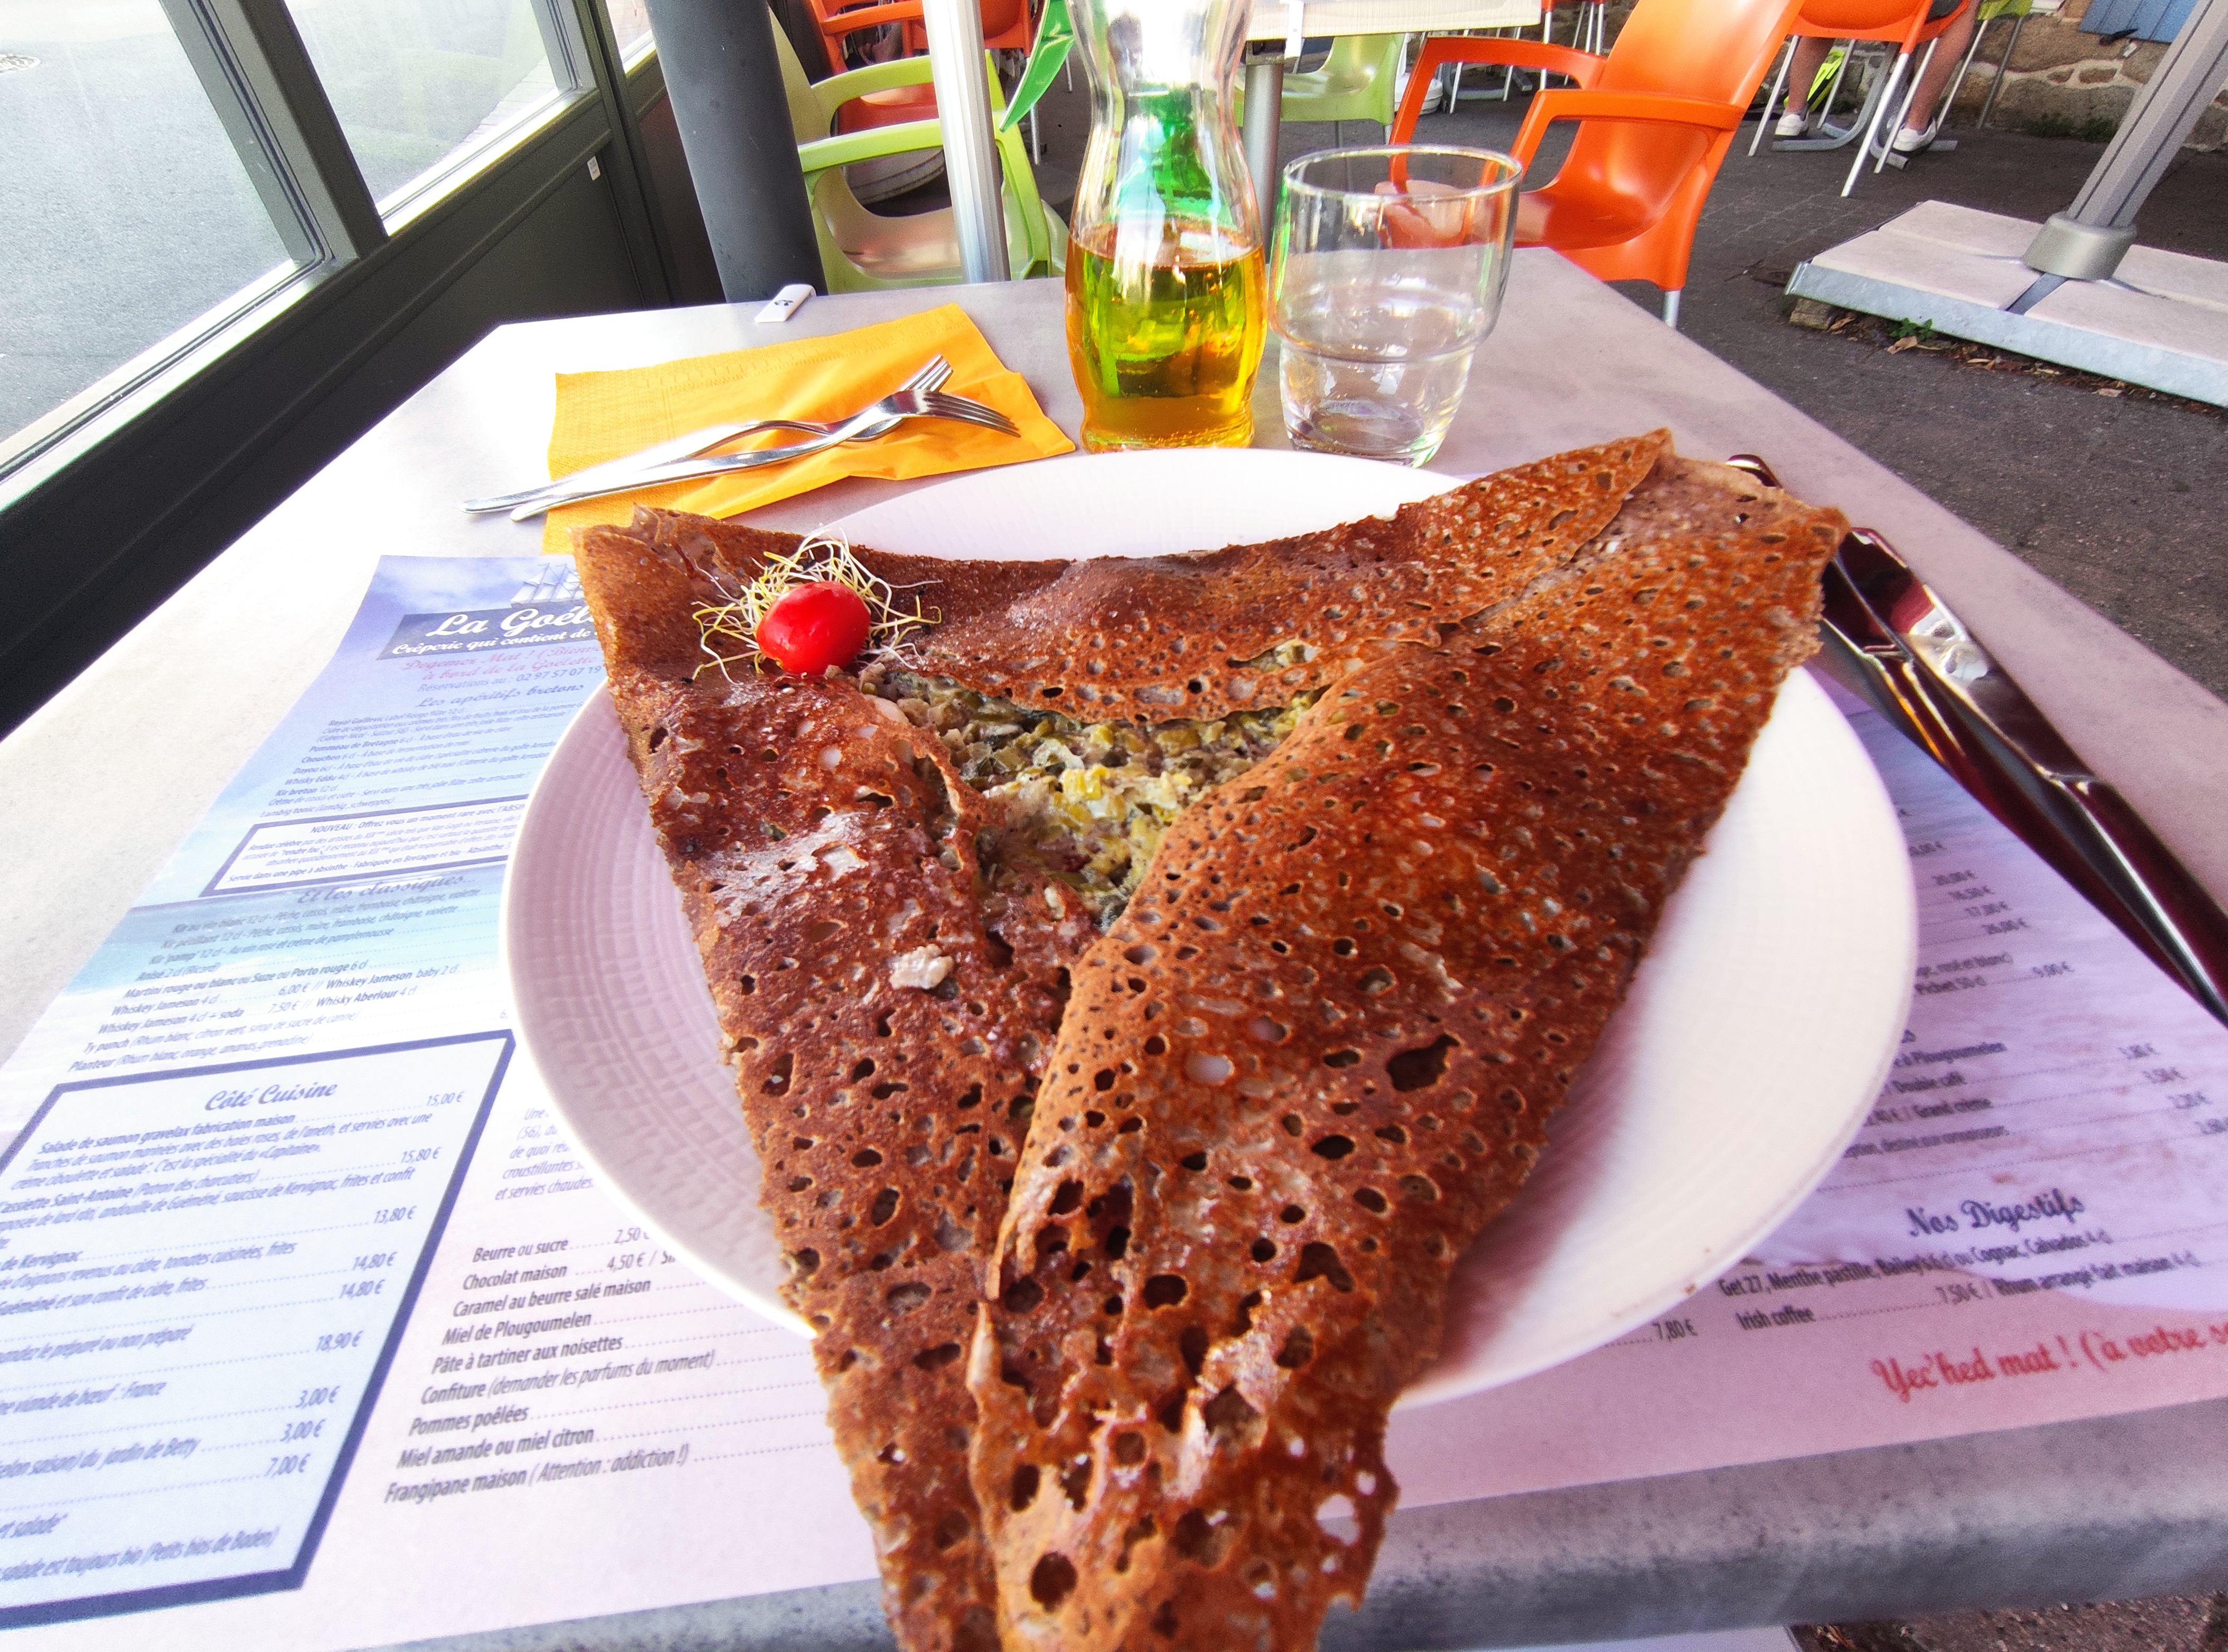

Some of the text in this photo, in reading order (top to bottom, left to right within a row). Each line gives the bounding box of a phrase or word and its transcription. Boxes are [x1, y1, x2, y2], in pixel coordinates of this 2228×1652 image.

[425, 605, 595, 637] La Goél
[392, 628, 591, 654] Crêperie qui contient de
[418, 678, 489, 693] Réservations
[517, 673, 533, 682] 02
[533, 671, 551, 680] 97
[551, 669, 568, 678] 57
[569, 668, 586, 677] 07
[589, 665, 602, 674] 19
[415, 684, 585, 708] Les apéritifs bretons
[310, 823, 353, 833] NOUVEAU
[358, 820, 384, 829] Offrez
[419, 812, 457, 822] moment
[111, 967, 441, 1016] Whiskey Jameson 6,00 € Whiskey Jameson baby
[123, 964, 350, 999] Martini rouge ou blanc ou Suze ou Porto rouge
[97, 990, 399, 1035] Whiskey Jameson soda 7,50 € Whisky Aberlour
[204, 1084, 338, 1111] Côté Cuisine
[37, 1139, 78, 1155] Salade
[77, 1136, 95, 1150] de
[93, 1133, 141, 1148] saumon
[191, 1119, 254, 1136] fabrication
[253, 1115, 296, 1128] maison
[426, 1092, 456, 1107] 15,00
[456, 1091, 464, 1103] €
[338, 1113, 433, 1134] et servies avec une
[524, 1108, 546, 1120] Une
[401, 1146, 441, 1163] 15,80 €
[509, 1145, 551, 1160] de quoi
[370, 1172, 384, 1185] et
[382, 1166, 416, 1183] confit
[502, 1160, 574, 1180] croustillantes
[495, 1187, 509, 1201] et
[507, 1184, 546, 1199] servies
[374, 1205, 417, 1224] 13,80 €
[1905, 1188, 2085, 1237] Nos Digestifs
[472, 1227, 642, 1263] Beurre ou sucre 2,50
[352, 1251, 398, 1271] 14,80 €
[462, 1252, 645, 1290] Chocolat maison 4,50 €
[339, 1279, 385, 1299] 14,80 €
[1717, 1278, 1748, 1297] Get
[1742, 1274, 1772, 1294] 27,
[1766, 1268, 1825, 1290] Menthe
[1822, 1260, 1882, 1288] pastille,
[453, 1280, 651, 1317] Caramel au beurre salé maison
[1735, 1309, 1773, 1331] Irish
[1770, 1304, 1817, 1326] coffee
[1934, 1283, 1971, 1306] 7,50
[1966, 1282, 1983, 1300] €
[316, 1330, 364, 1352] 18,90 €
[442, 1311, 592, 1345] Miel de Plougoumelen
[1651, 1318, 1697, 1342] 7,80 €
[431, 1336, 624, 1375] Pâte à tartiner aux noisettes
[1869, 1325, 2208, 1404] Yec'hed mat ! (à votre
[420, 1349, 715, 1405] Confiture (demander les parfums du moment)
[295, 1385, 340, 1409] 3,00 €
[279, 1418, 326, 1443] 3,00 €
[408, 1405, 529, 1436] Pommes poêlées
[396, 1428, 595, 1469] Miel amande ou miel citron
[264, 1453, 311, 1478] 7,00 €
[384, 1477, 471, 1505] Frangipane
[471, 1469, 528, 1492] maison
[536, 1459, 603, 1482] Attention
[610, 1449, 676, 1473] addiction
